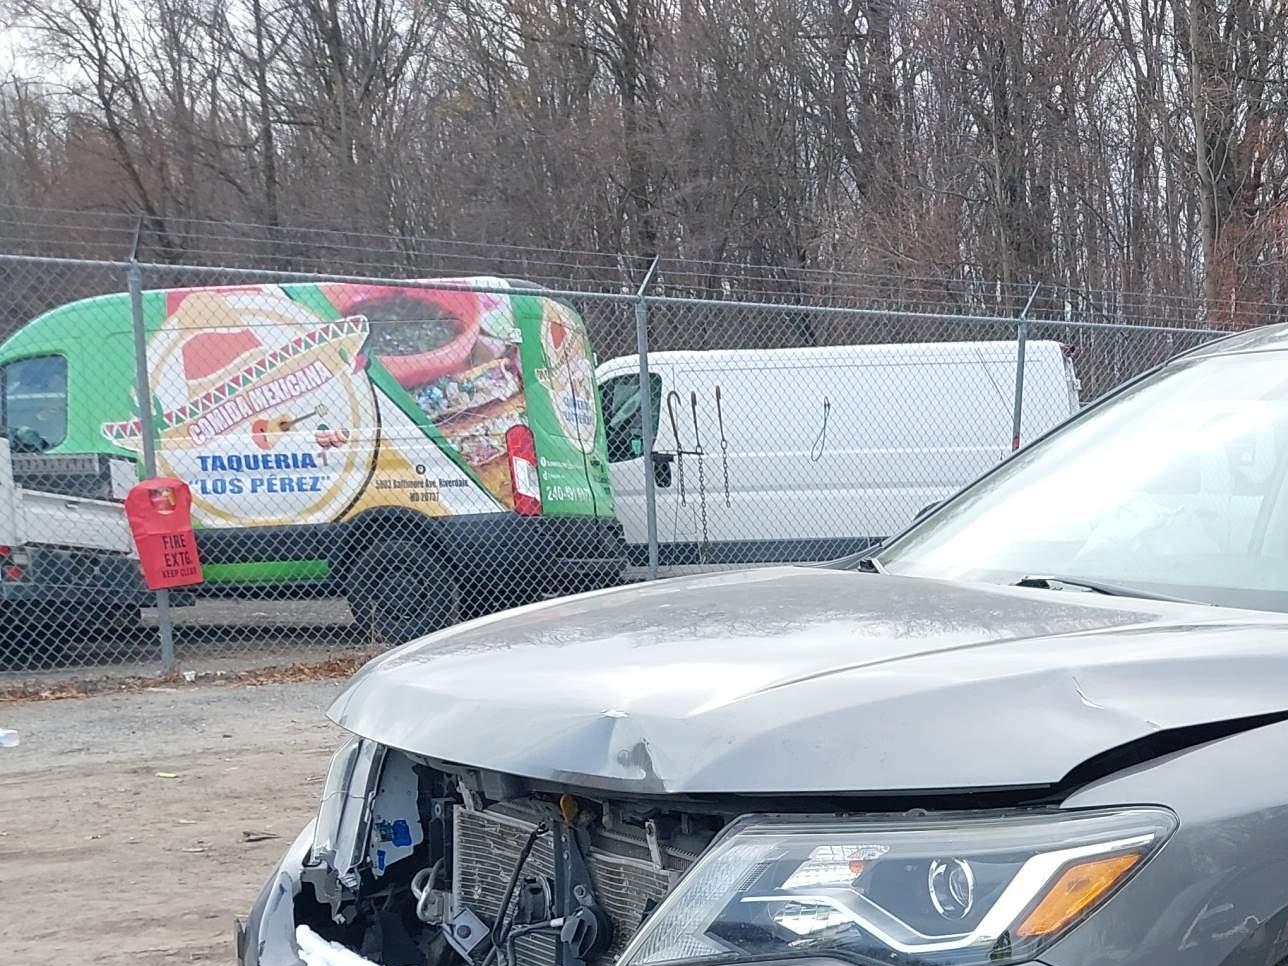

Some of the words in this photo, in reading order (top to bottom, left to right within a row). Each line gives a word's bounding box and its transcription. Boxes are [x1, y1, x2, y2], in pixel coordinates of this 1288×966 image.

[187, 395, 253, 446] COMIDA
[247, 359, 334, 412] MEXICANA
[196, 453, 317, 473] TAQUERIA
[162, 534, 187, 550] FIRE
[161, 568, 179, 578] KEEP
